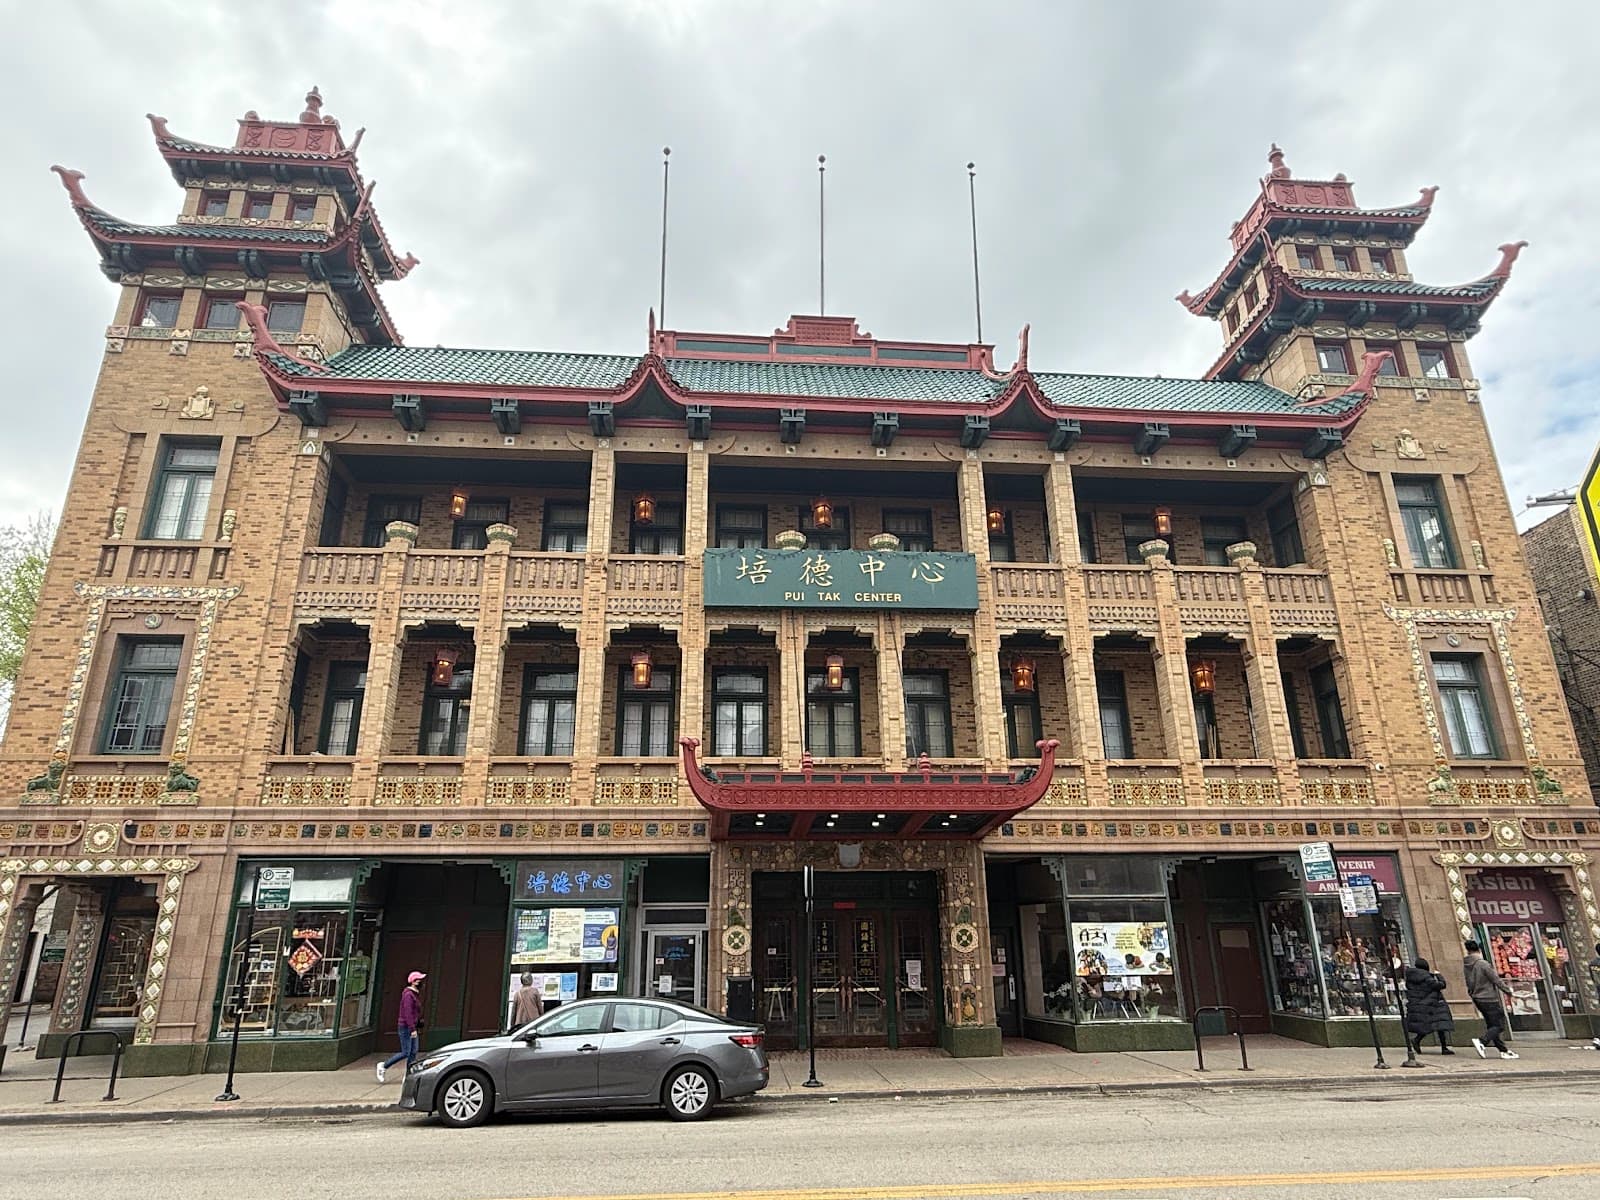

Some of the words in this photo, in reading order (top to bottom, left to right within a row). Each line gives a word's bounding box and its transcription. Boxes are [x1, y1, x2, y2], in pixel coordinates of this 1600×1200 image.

[735, 554, 946, 588] 培德中心
[784, 591, 805, 602] PUI
[817, 591, 841, 602] TAK
[854, 592, 902, 603] CENTER
[1337, 860, 1376, 870] VENIR
[527, 870, 613, 894] 培德中心
[1468, 873, 1536, 891] Asian
[1467, 897, 1544, 919] Image
